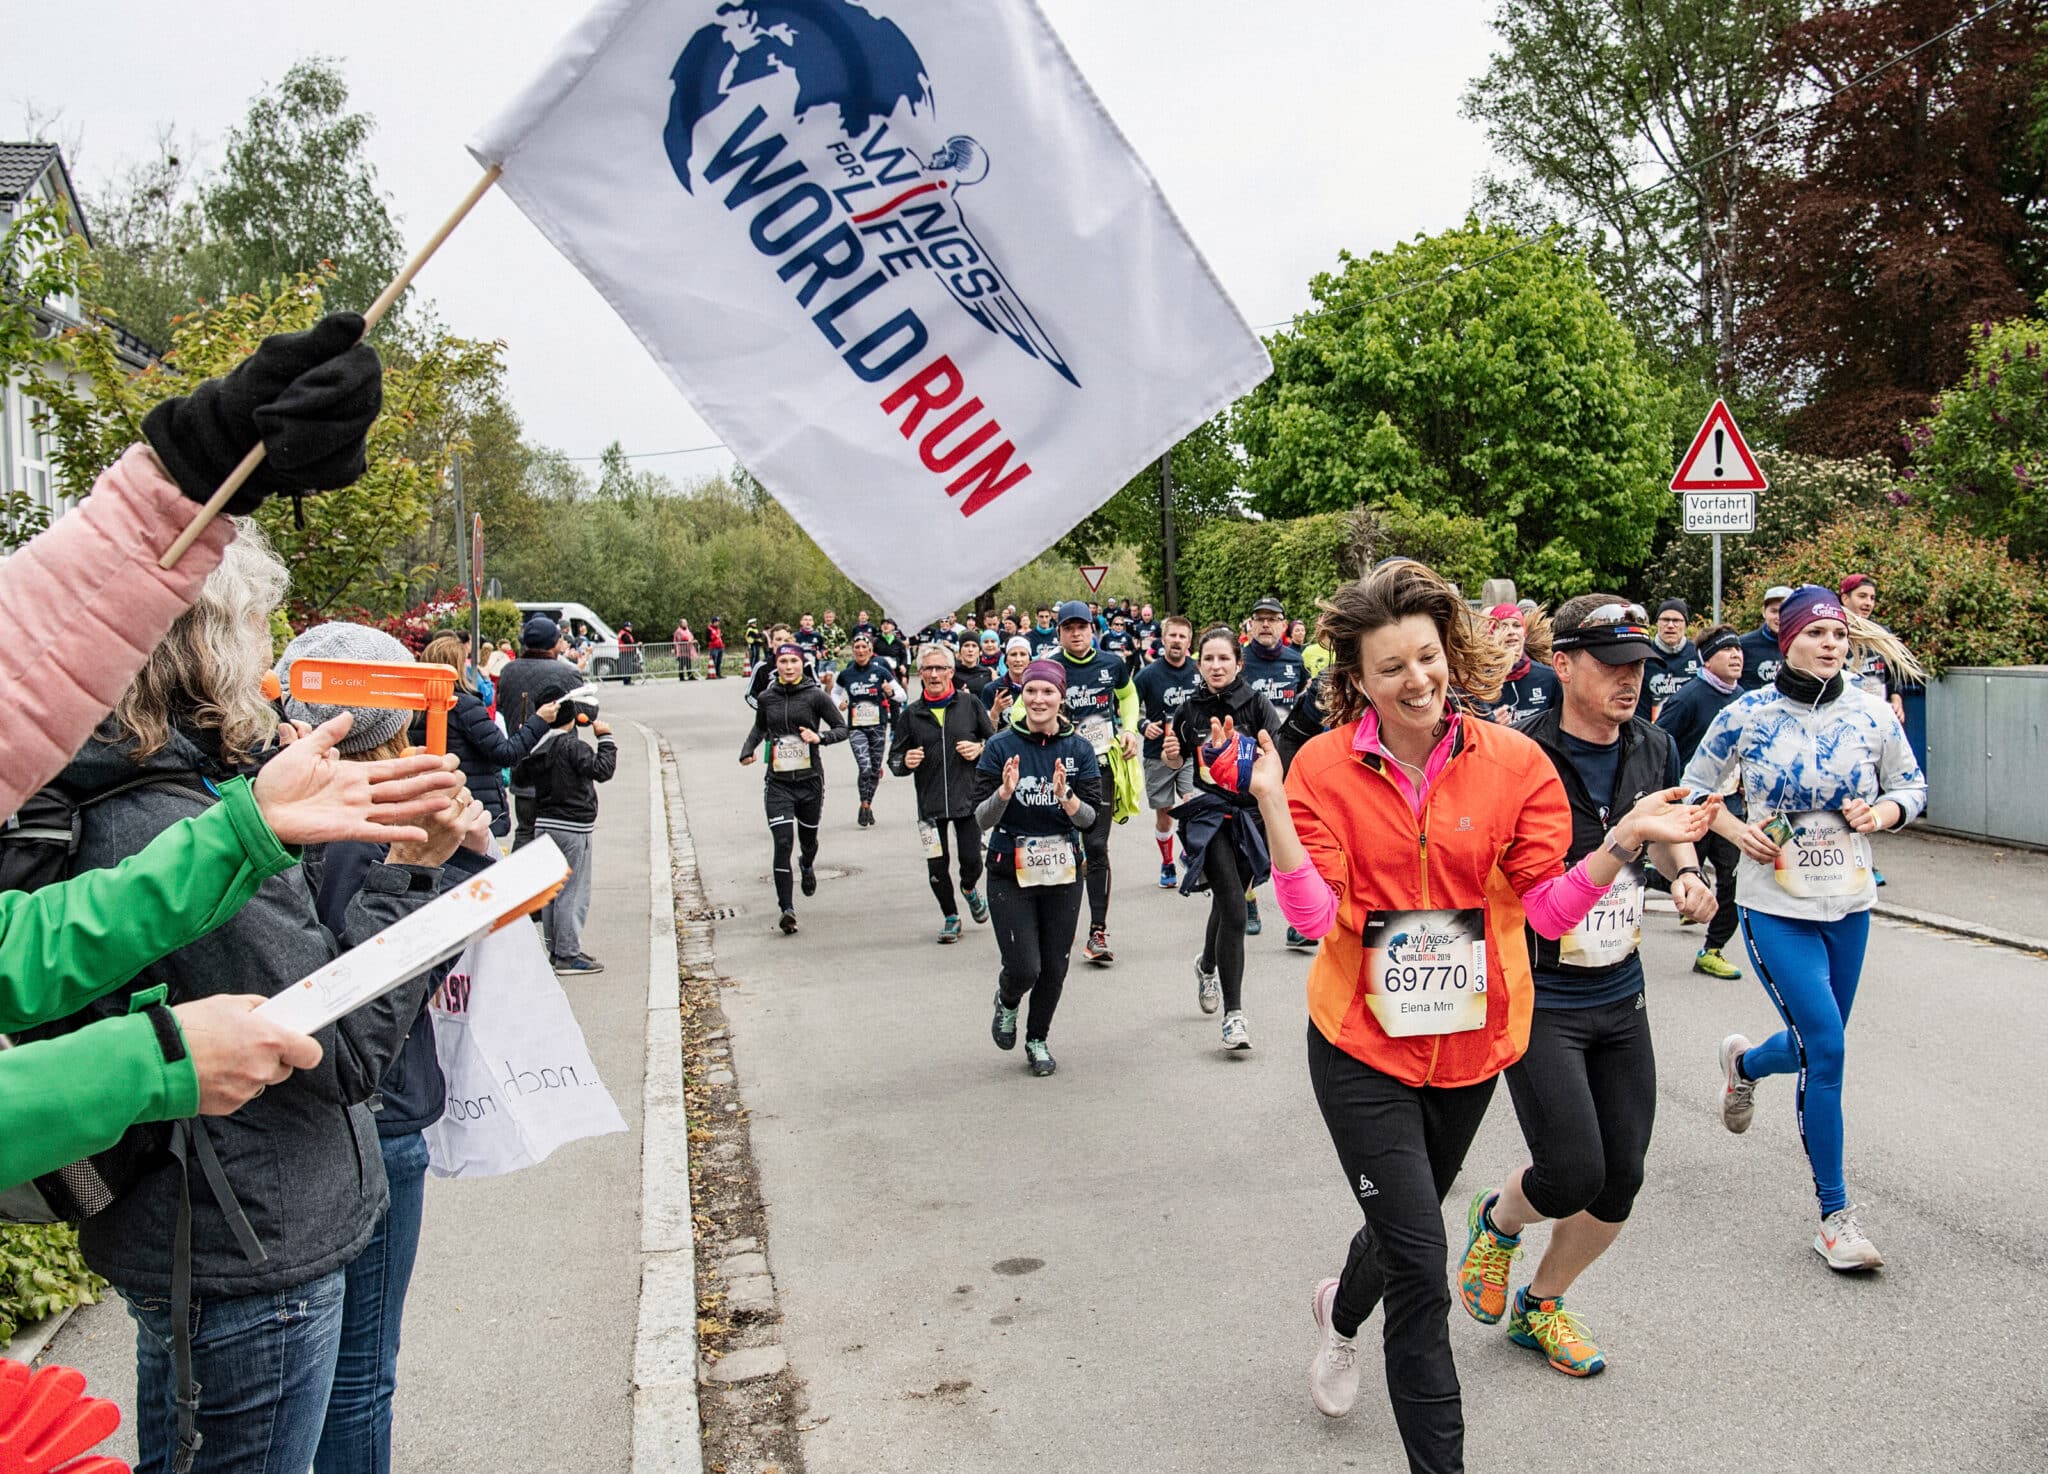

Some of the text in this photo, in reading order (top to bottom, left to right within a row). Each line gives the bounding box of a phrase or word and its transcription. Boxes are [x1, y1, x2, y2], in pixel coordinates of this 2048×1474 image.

[826, 141, 865, 179] FOR
[832, 181, 934, 278] LIFE
[702, 104, 1033, 519] WORLD RUN
[1690, 496, 1747, 510] Vorfahrt
[1688, 511, 1749, 528] geändert
[330, 677, 344, 686] Go
[1026, 852, 1067, 867] 32618
[1797, 848, 1845, 867] 2050
[1855, 855, 1863, 868] 3
[1804, 873, 1842, 881] Franziska
[1586, 906, 1634, 932] 17114
[1401, 953, 1422, 962] WORLD
[1437, 953, 1451, 961] 2019
[1384, 964, 1467, 993] 69770
[1475, 974, 1485, 992] 3
[1400, 1002, 1431, 1013] Elena
